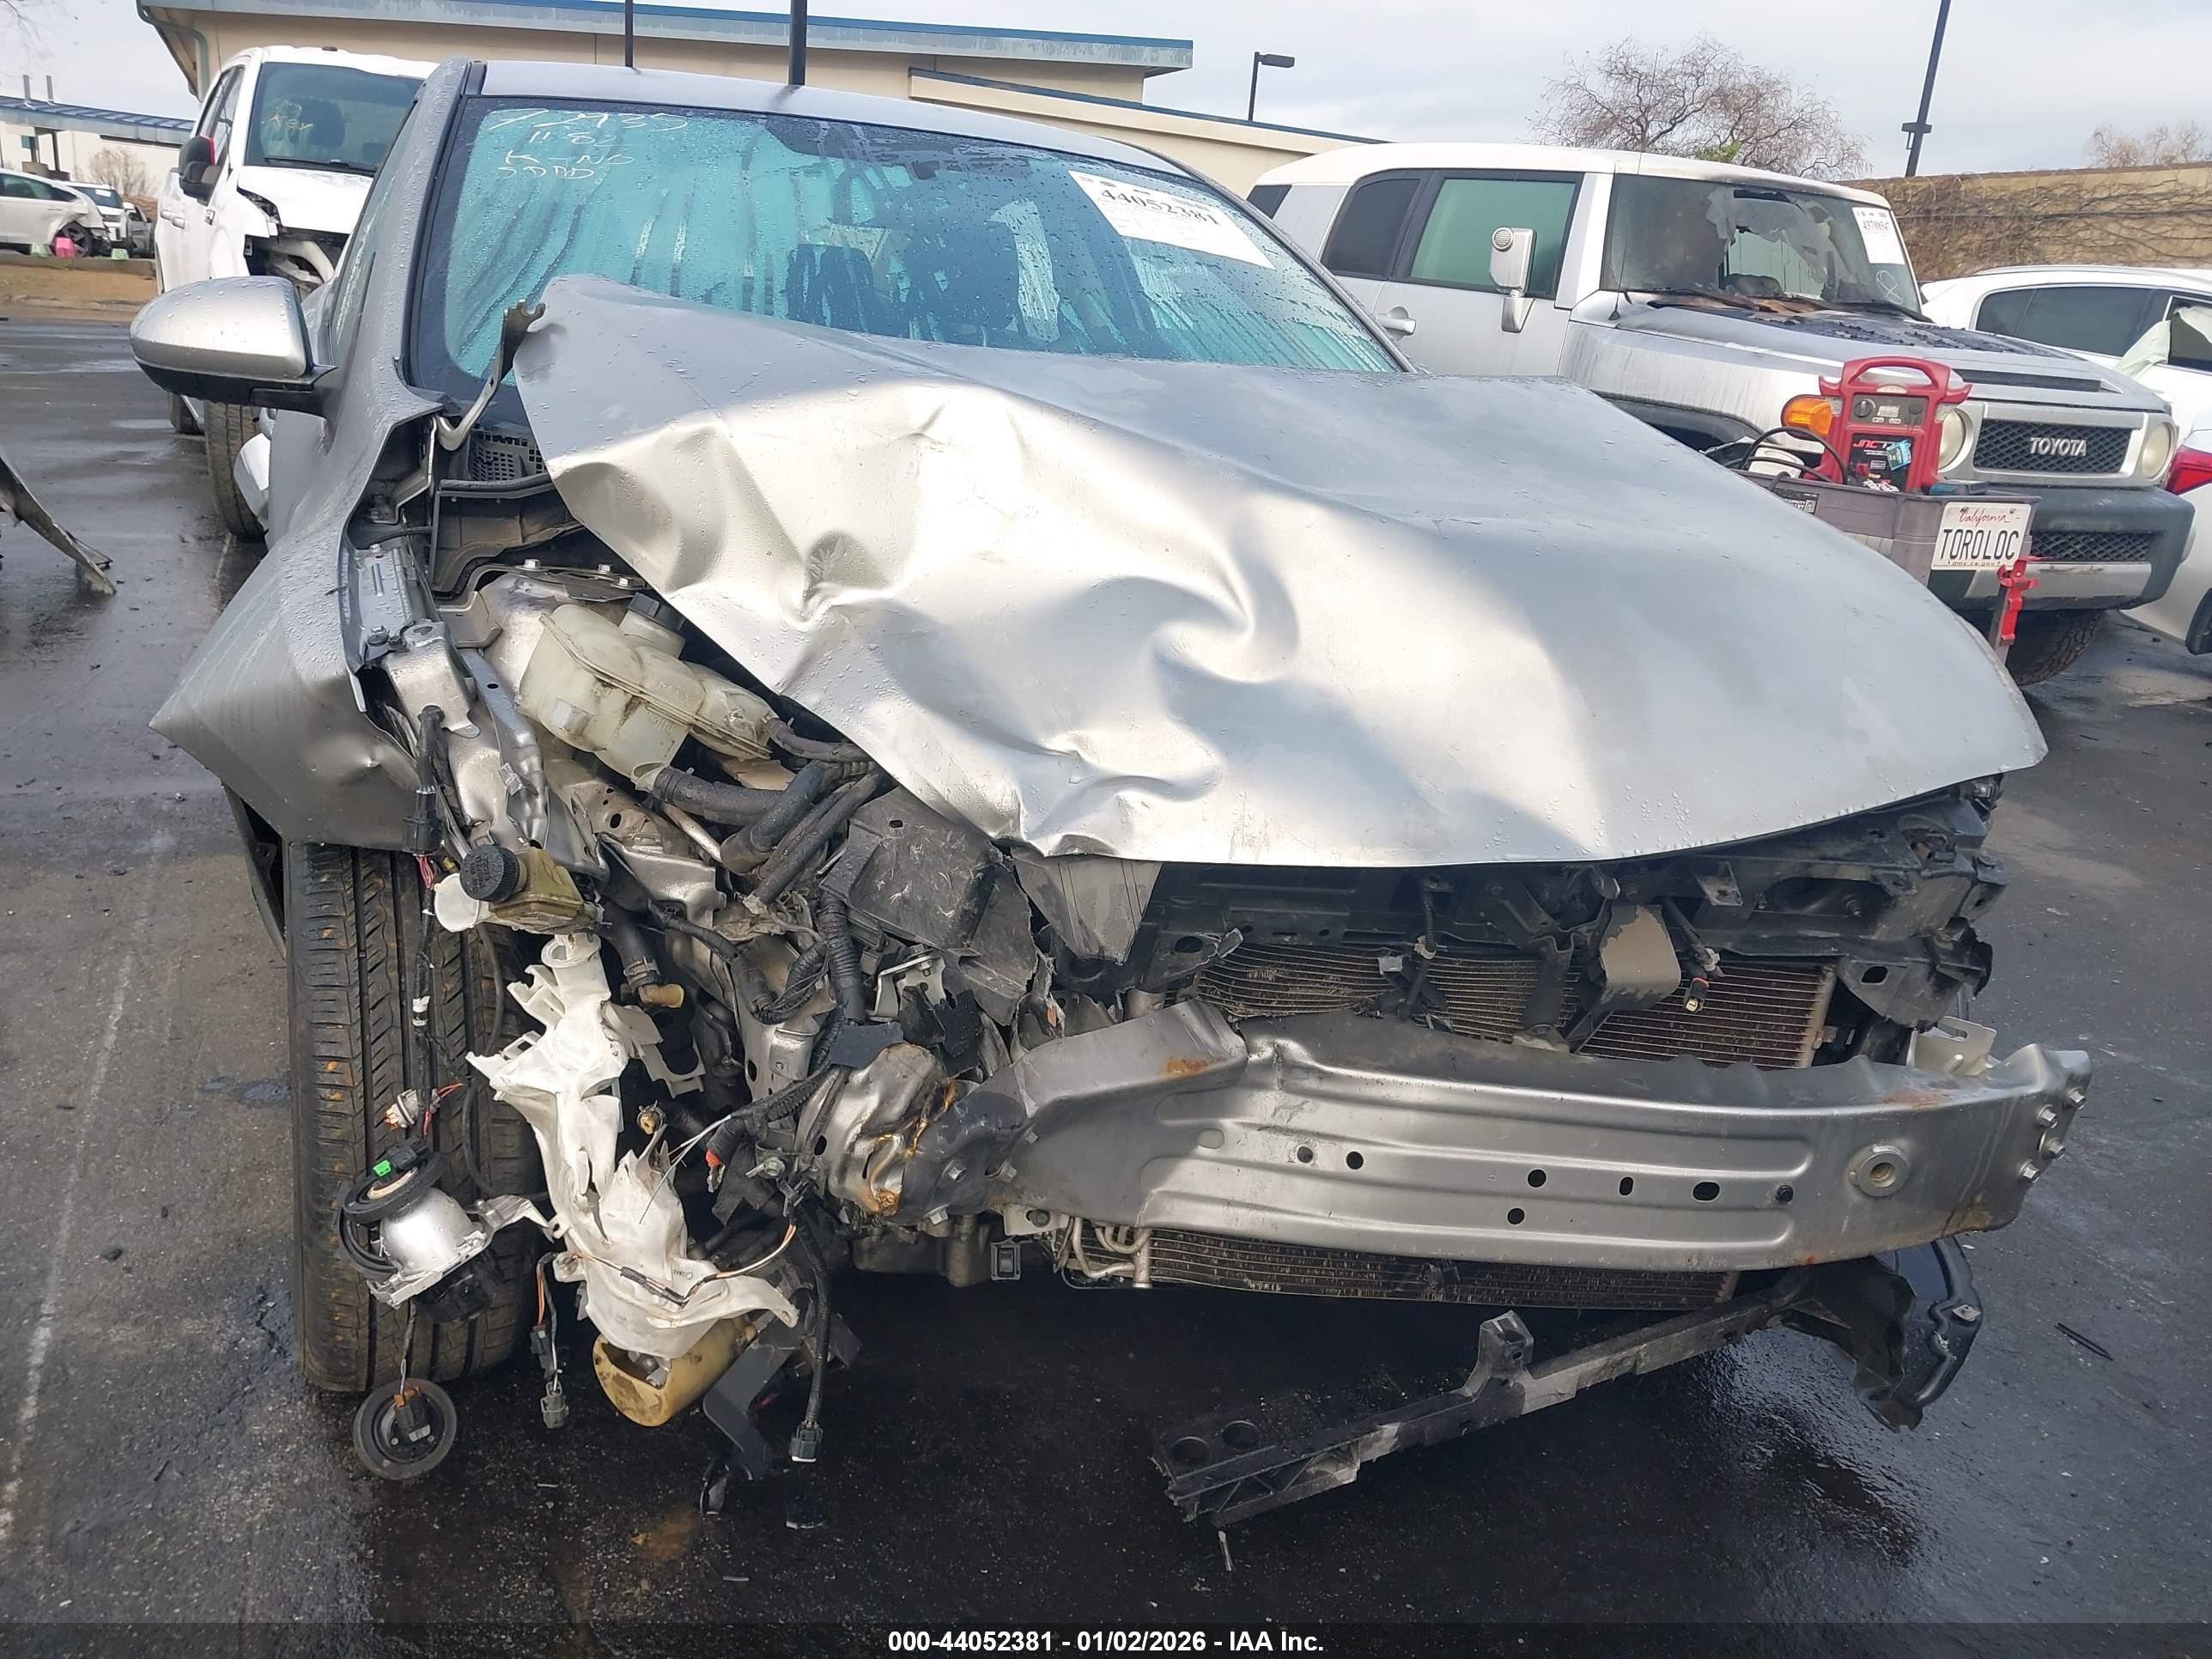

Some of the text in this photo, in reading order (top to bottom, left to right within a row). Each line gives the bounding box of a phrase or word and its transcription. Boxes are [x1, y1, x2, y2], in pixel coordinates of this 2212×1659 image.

[1102, 190, 1219, 225] 44052381
[2029, 436, 2087, 456] TOYOTA
[1959, 507, 2012, 527] California
[1940, 528, 2020, 560] TOROLOC
[647, 712, 676, 732] MIN
